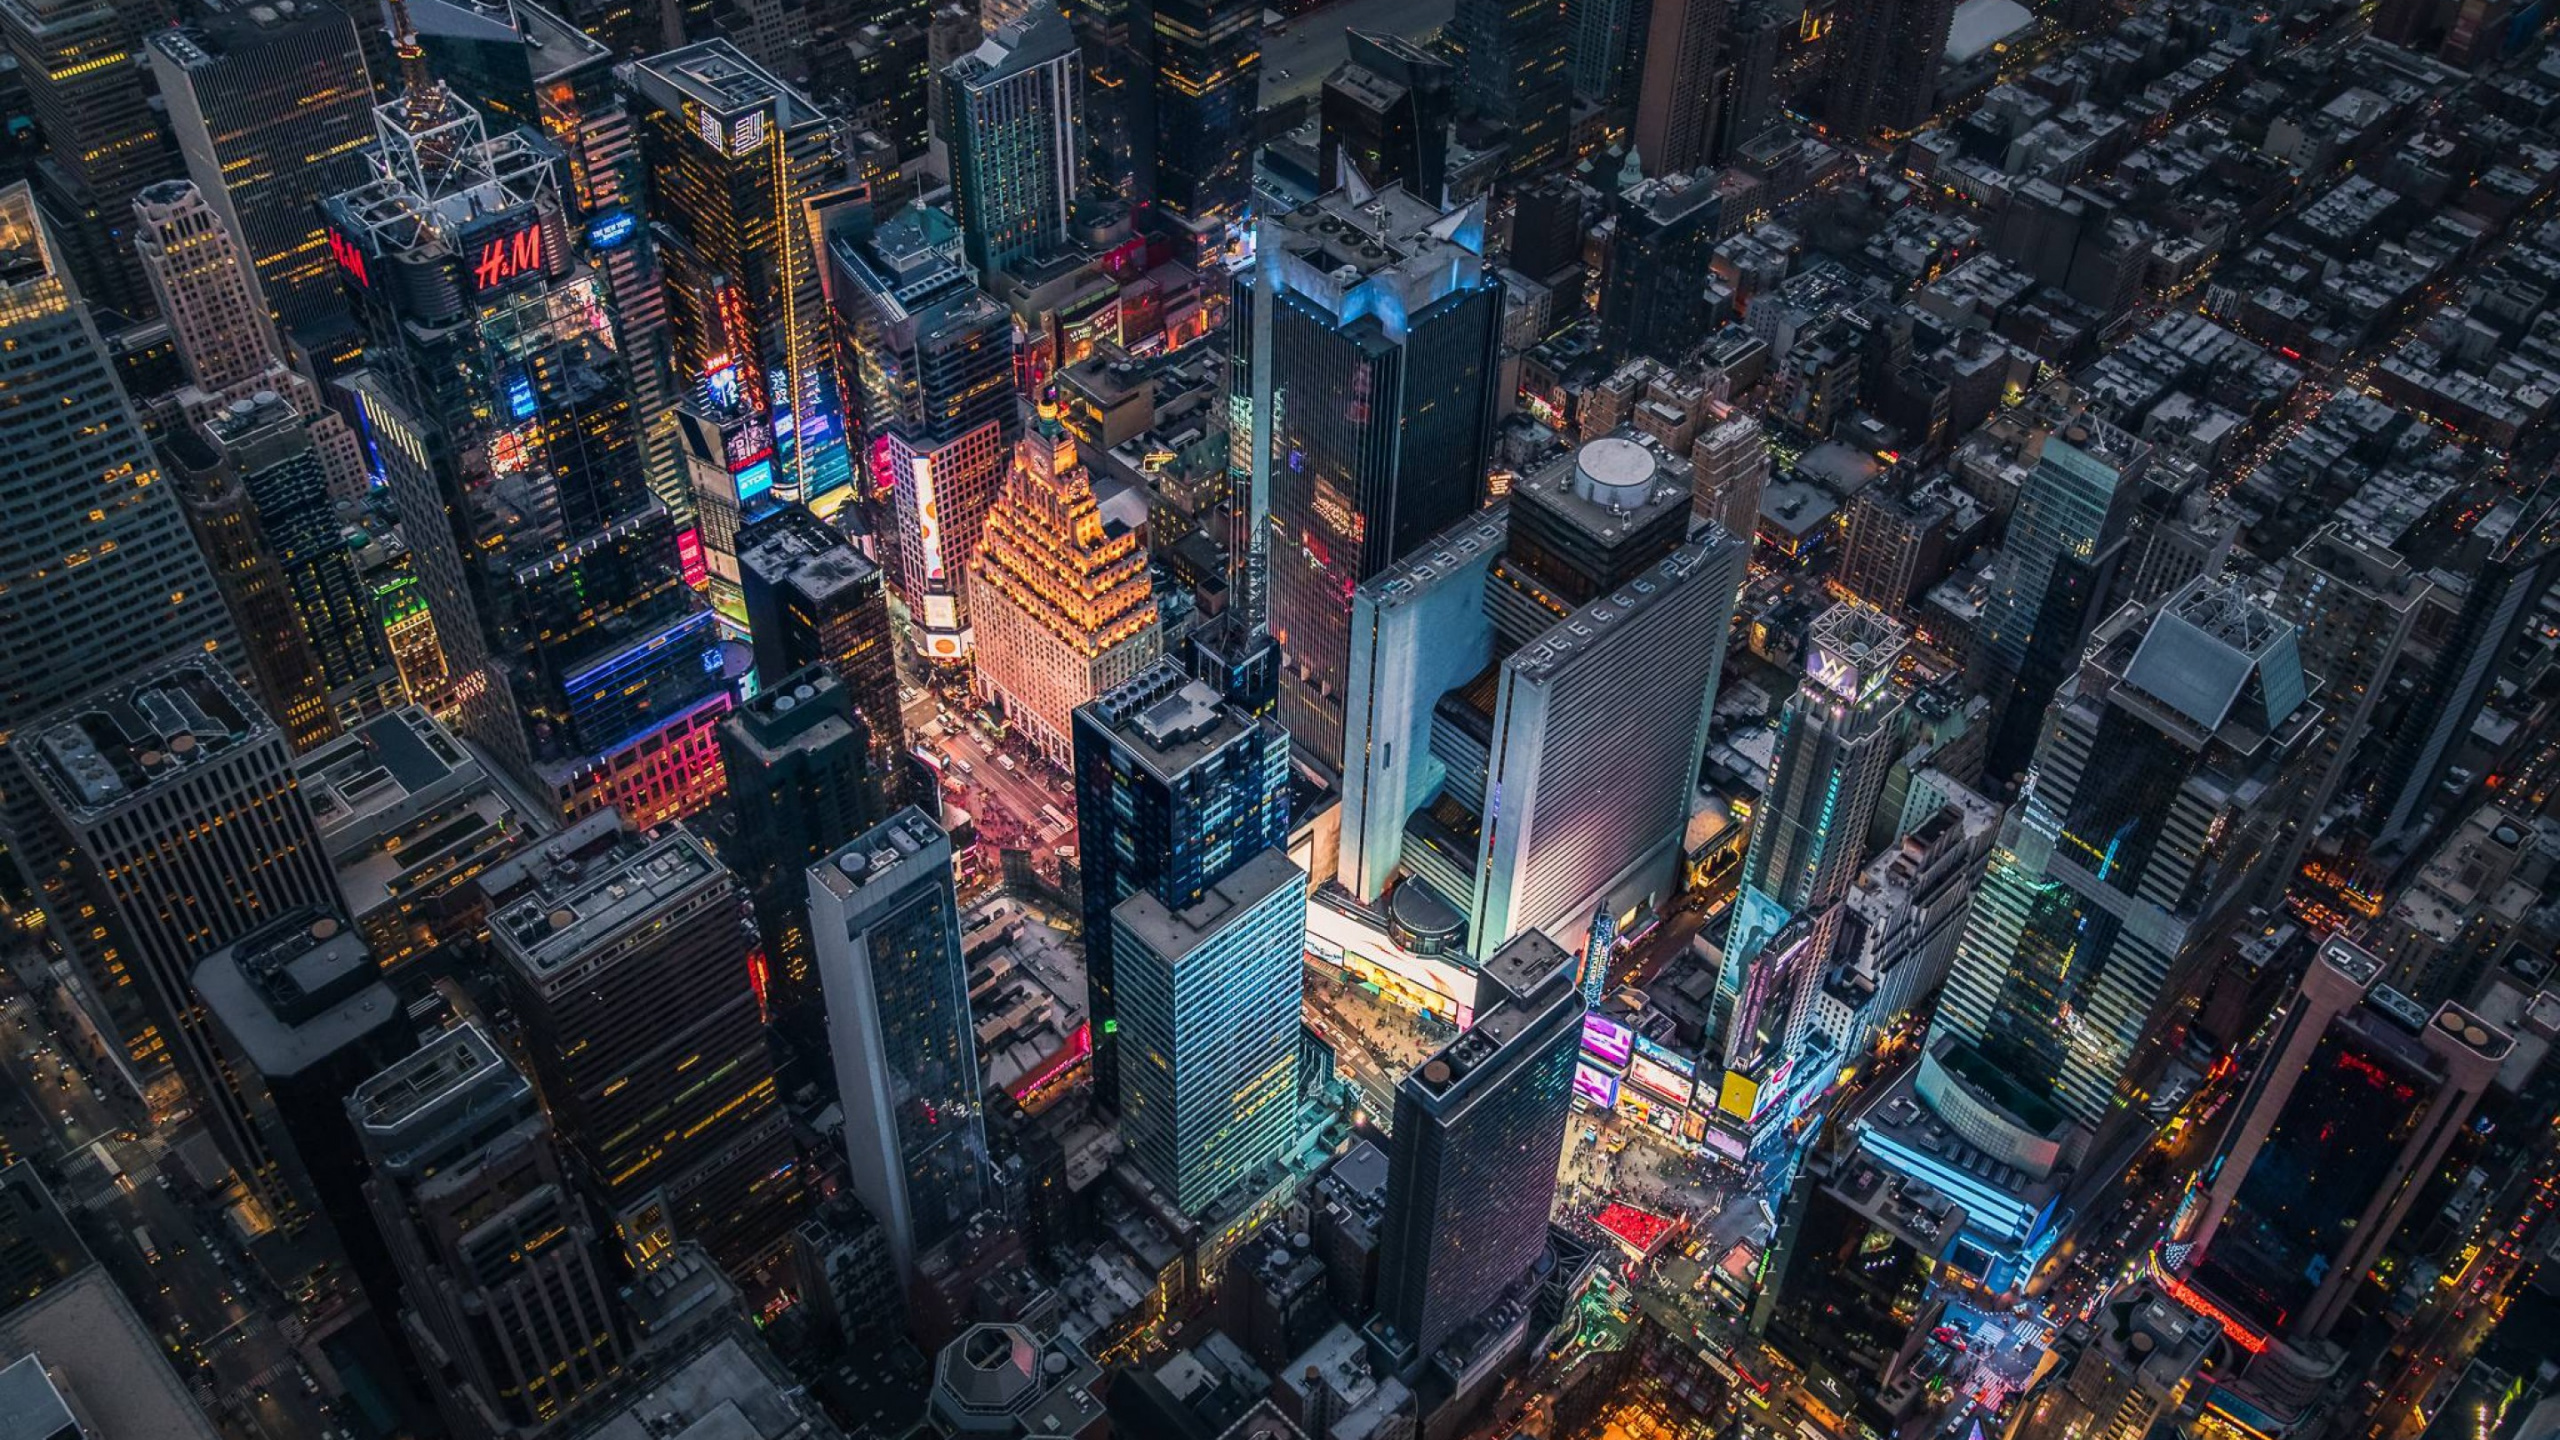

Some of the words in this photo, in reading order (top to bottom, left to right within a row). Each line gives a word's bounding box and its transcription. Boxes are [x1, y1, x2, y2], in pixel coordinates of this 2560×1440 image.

[329, 226, 369, 288] H&M
[474, 224, 540, 290] H&M
[715, 291, 738, 359] ERNST
[728, 447, 773, 474] TOSHIBA
[749, 471, 769, 486] TDK
[1819, 649, 1848, 680] W
[1825, 1377, 1838, 1393] R
